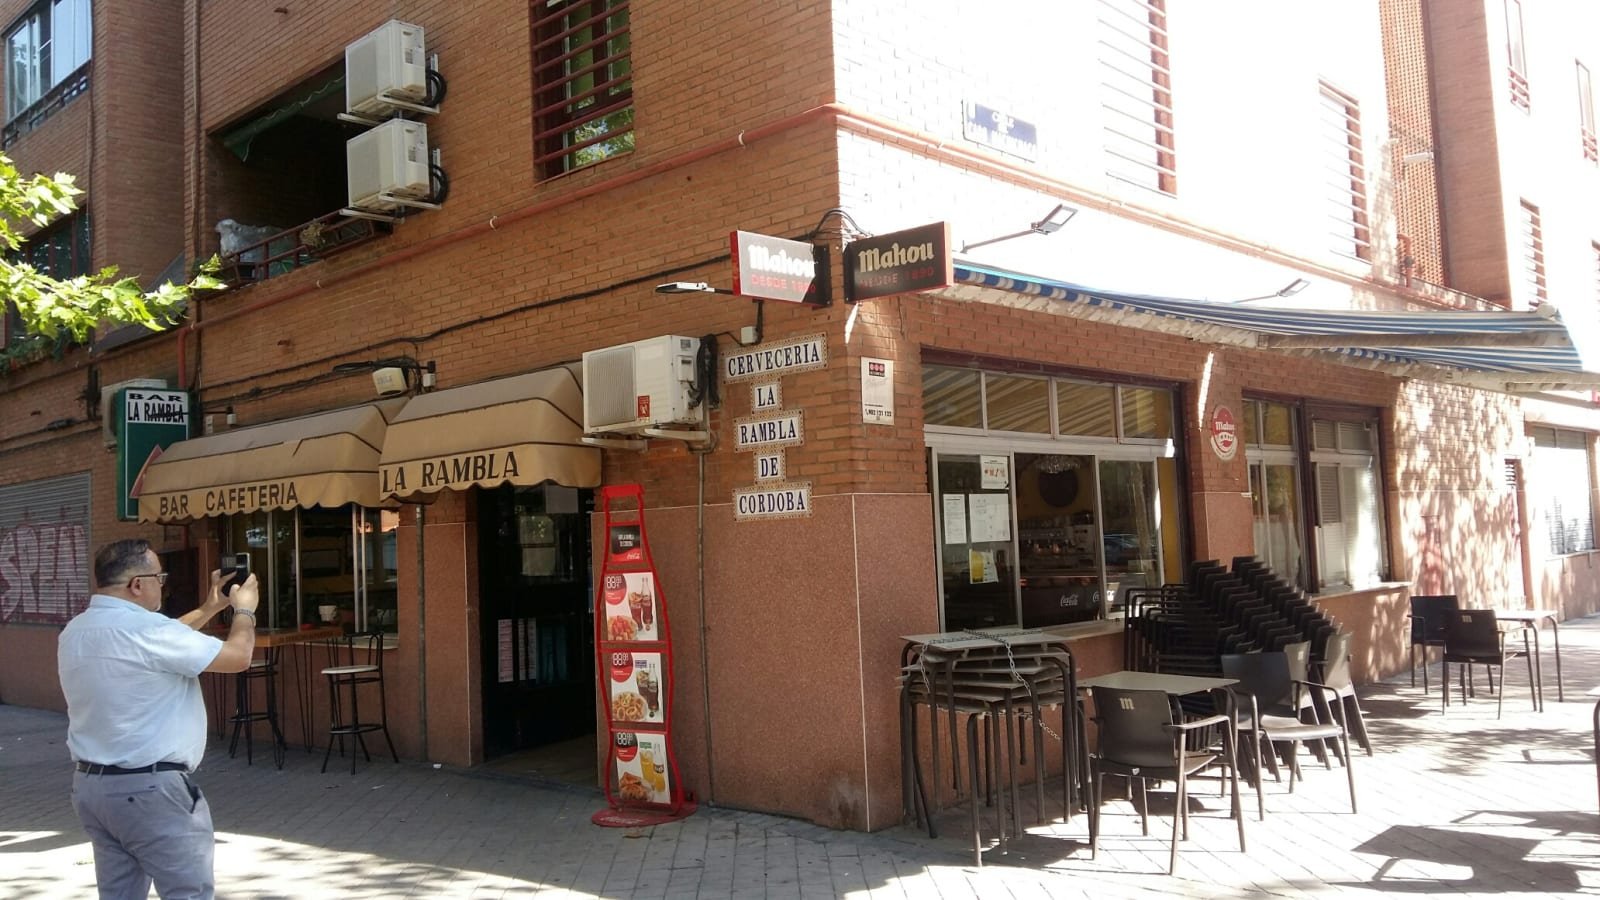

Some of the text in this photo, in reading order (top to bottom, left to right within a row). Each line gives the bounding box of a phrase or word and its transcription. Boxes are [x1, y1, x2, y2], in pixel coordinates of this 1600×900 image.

[747, 244, 816, 278] Mahou
[858, 242, 935, 273] Mahou
[751, 274, 787, 289] DESDE
[728, 342, 820, 376] CERVECERIA
[128, 393, 184, 402] BAR
[757, 386, 776, 407] LA
[128, 401, 184, 423] LA RAMBLA
[741, 420, 796, 444] RAMBLA
[382, 451, 519, 493] LA RAMBLA
[761, 457, 779, 477] DE
[159, 481, 298, 515] BAR CAFETERIA
[740, 491, 805, 514] CORDOBA
